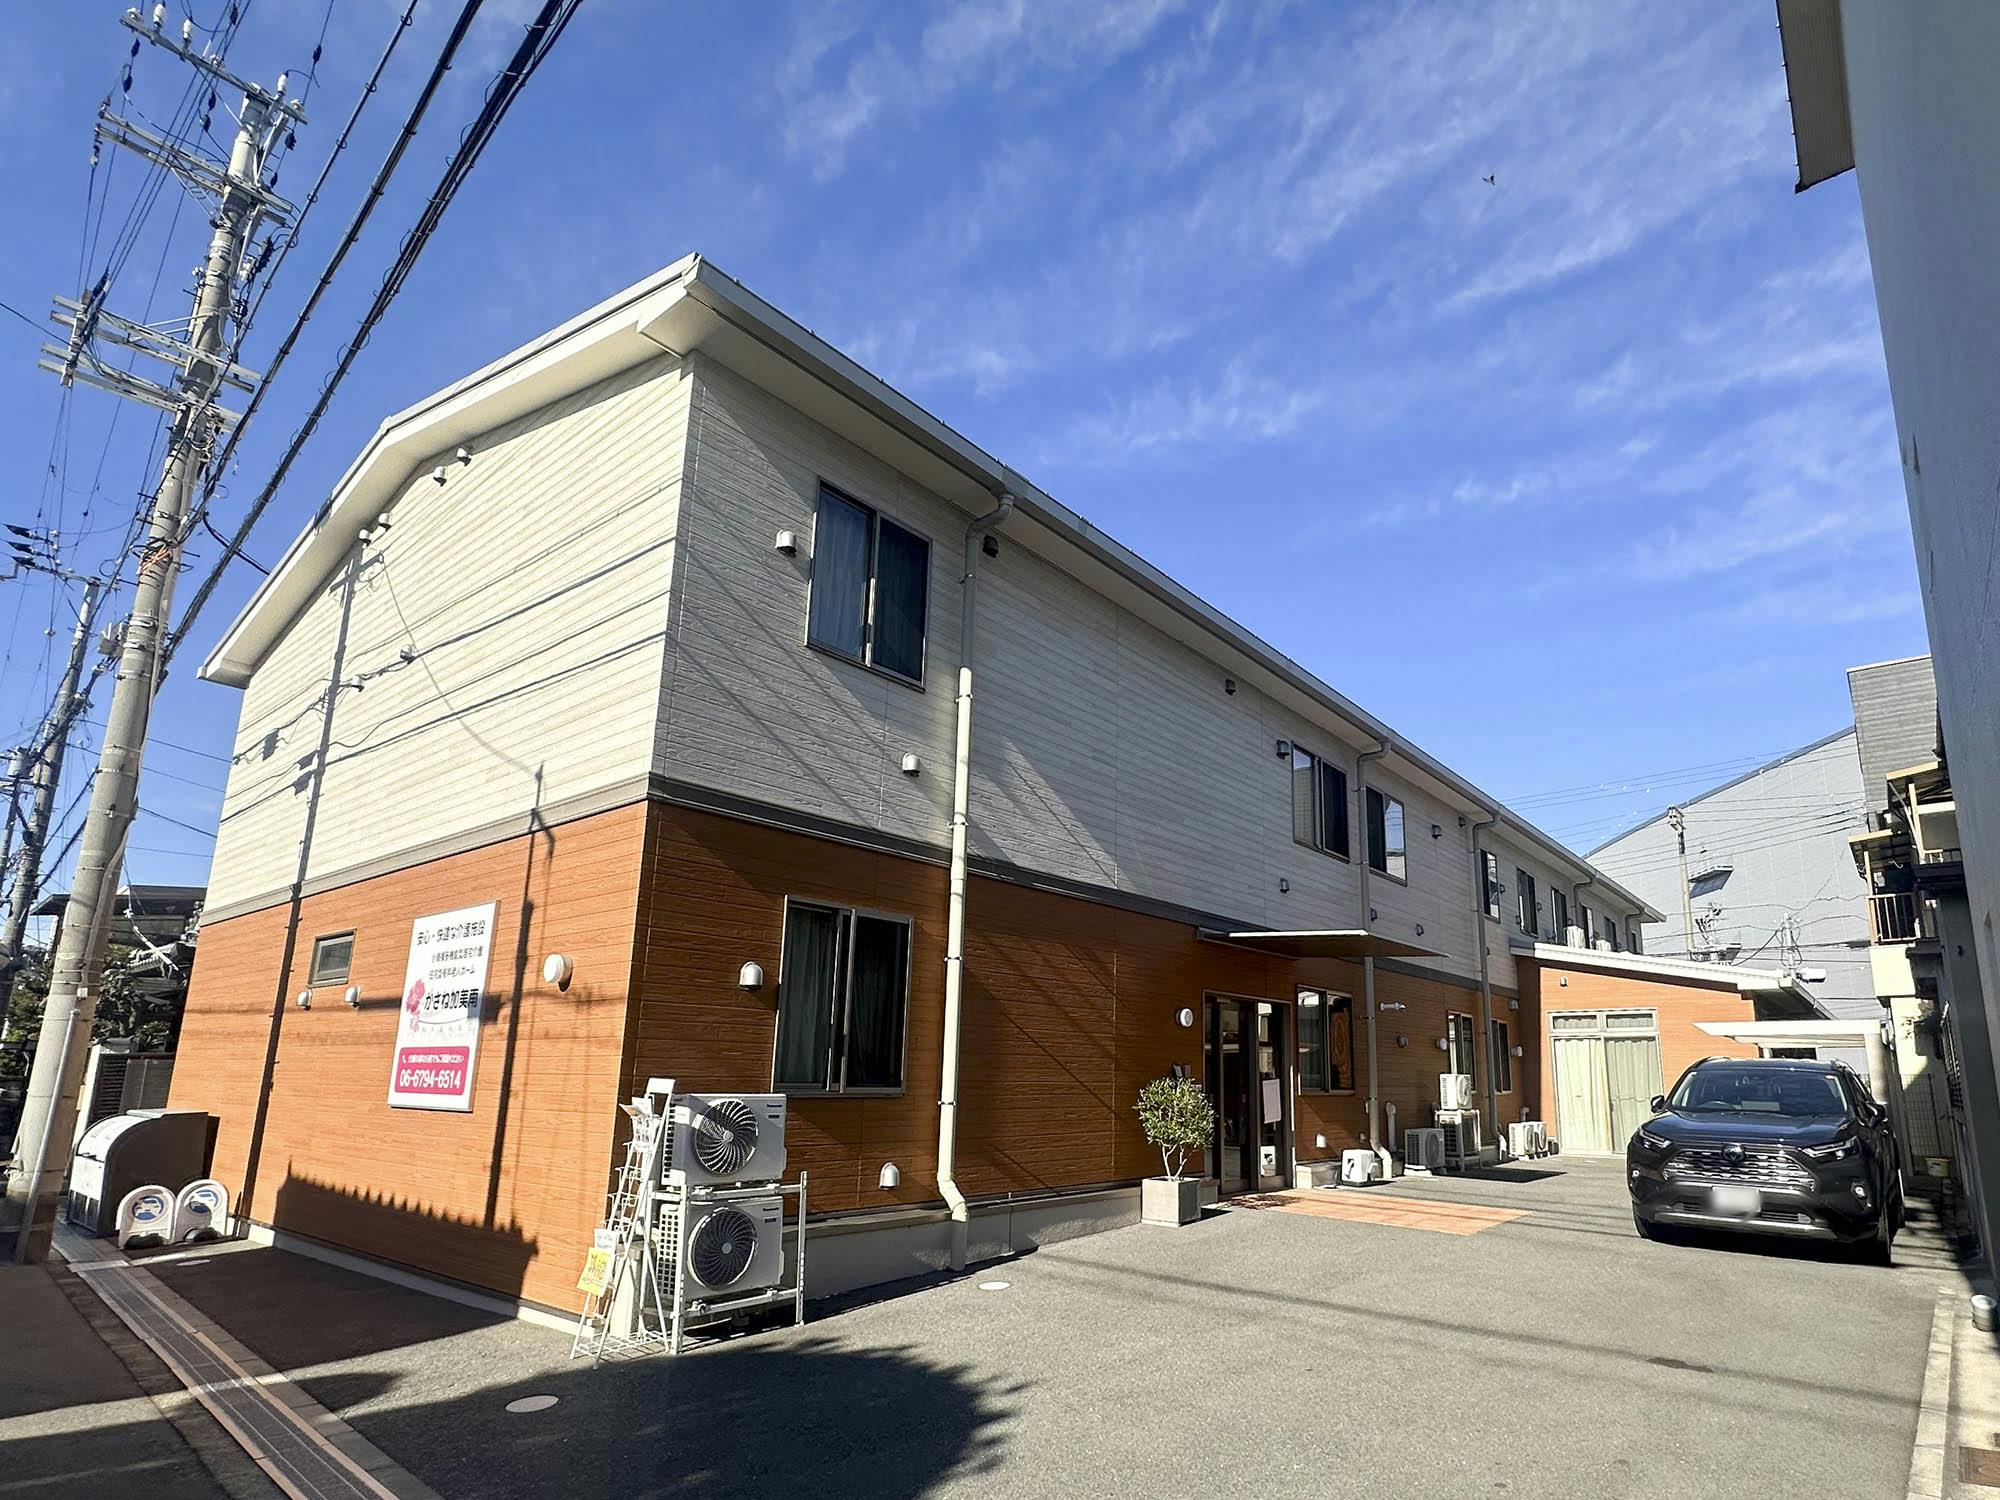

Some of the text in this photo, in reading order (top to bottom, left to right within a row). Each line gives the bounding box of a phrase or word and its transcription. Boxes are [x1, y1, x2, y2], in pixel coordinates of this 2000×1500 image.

[424, 988, 479, 1010] かさね加美南
[399, 1069, 462, 1089] 06-6794-6514
